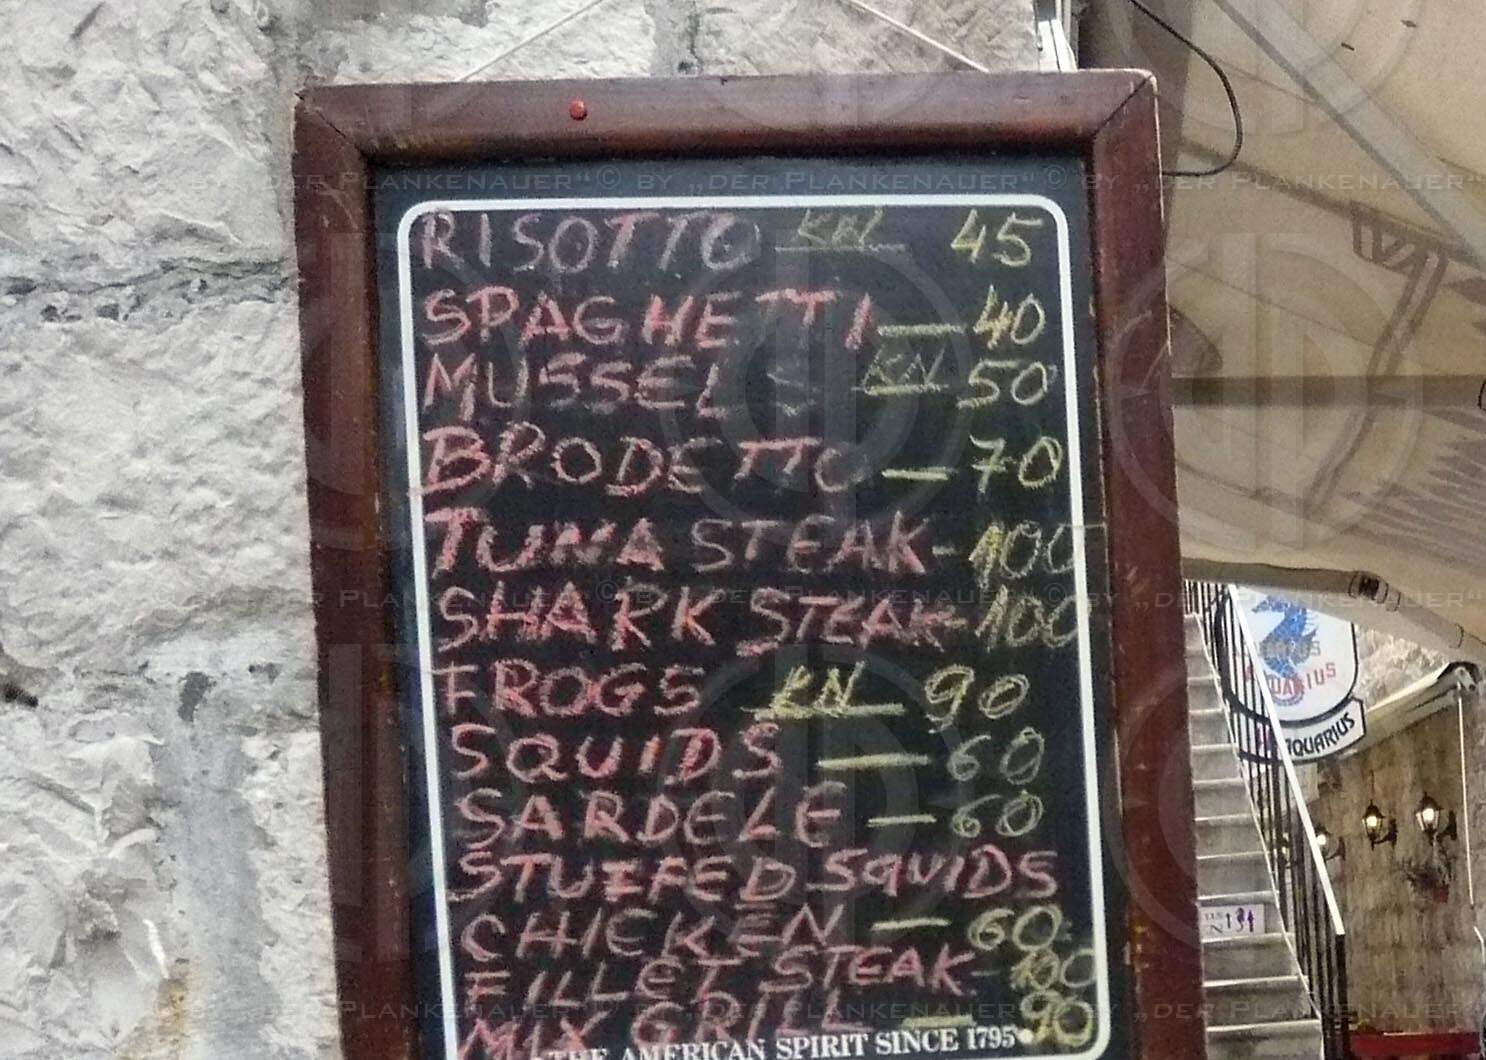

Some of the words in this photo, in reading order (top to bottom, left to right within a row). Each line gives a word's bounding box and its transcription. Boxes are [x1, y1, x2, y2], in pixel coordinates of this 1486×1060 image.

[421, 208, 761, 274] RISOTTO
[950, 208, 1044, 267] 45
[422, 285, 875, 350] SPAGHETTI
[973, 284, 1046, 350] 40
[956, 359, 1050, 410] 50
[409, 421, 867, 497] BRODETTO
[969, 434, 1063, 494] 70
[690, 510, 927, 574] STEAK
[437, 578, 726, 652] SHARK
[736, 586, 953, 657] STEAK
[431, 658, 705, 717] FROGS
[924, 663, 1030, 734] 90
[451, 722, 783, 786] SQUIDS
[947, 726, 1045, 786] 60
[453, 780, 849, 850] SARDELE
[950, 789, 1045, 838] 60
[461, 903, 845, 962] CHICKEN
[966, 904, 1064, 952] 60
[464, 955, 743, 1012] FILLET
[758, 943, 977, 997] STEAK
[875, 1026, 959, 1055] SINCE
[966, 1023, 1018, 1049] 1795
